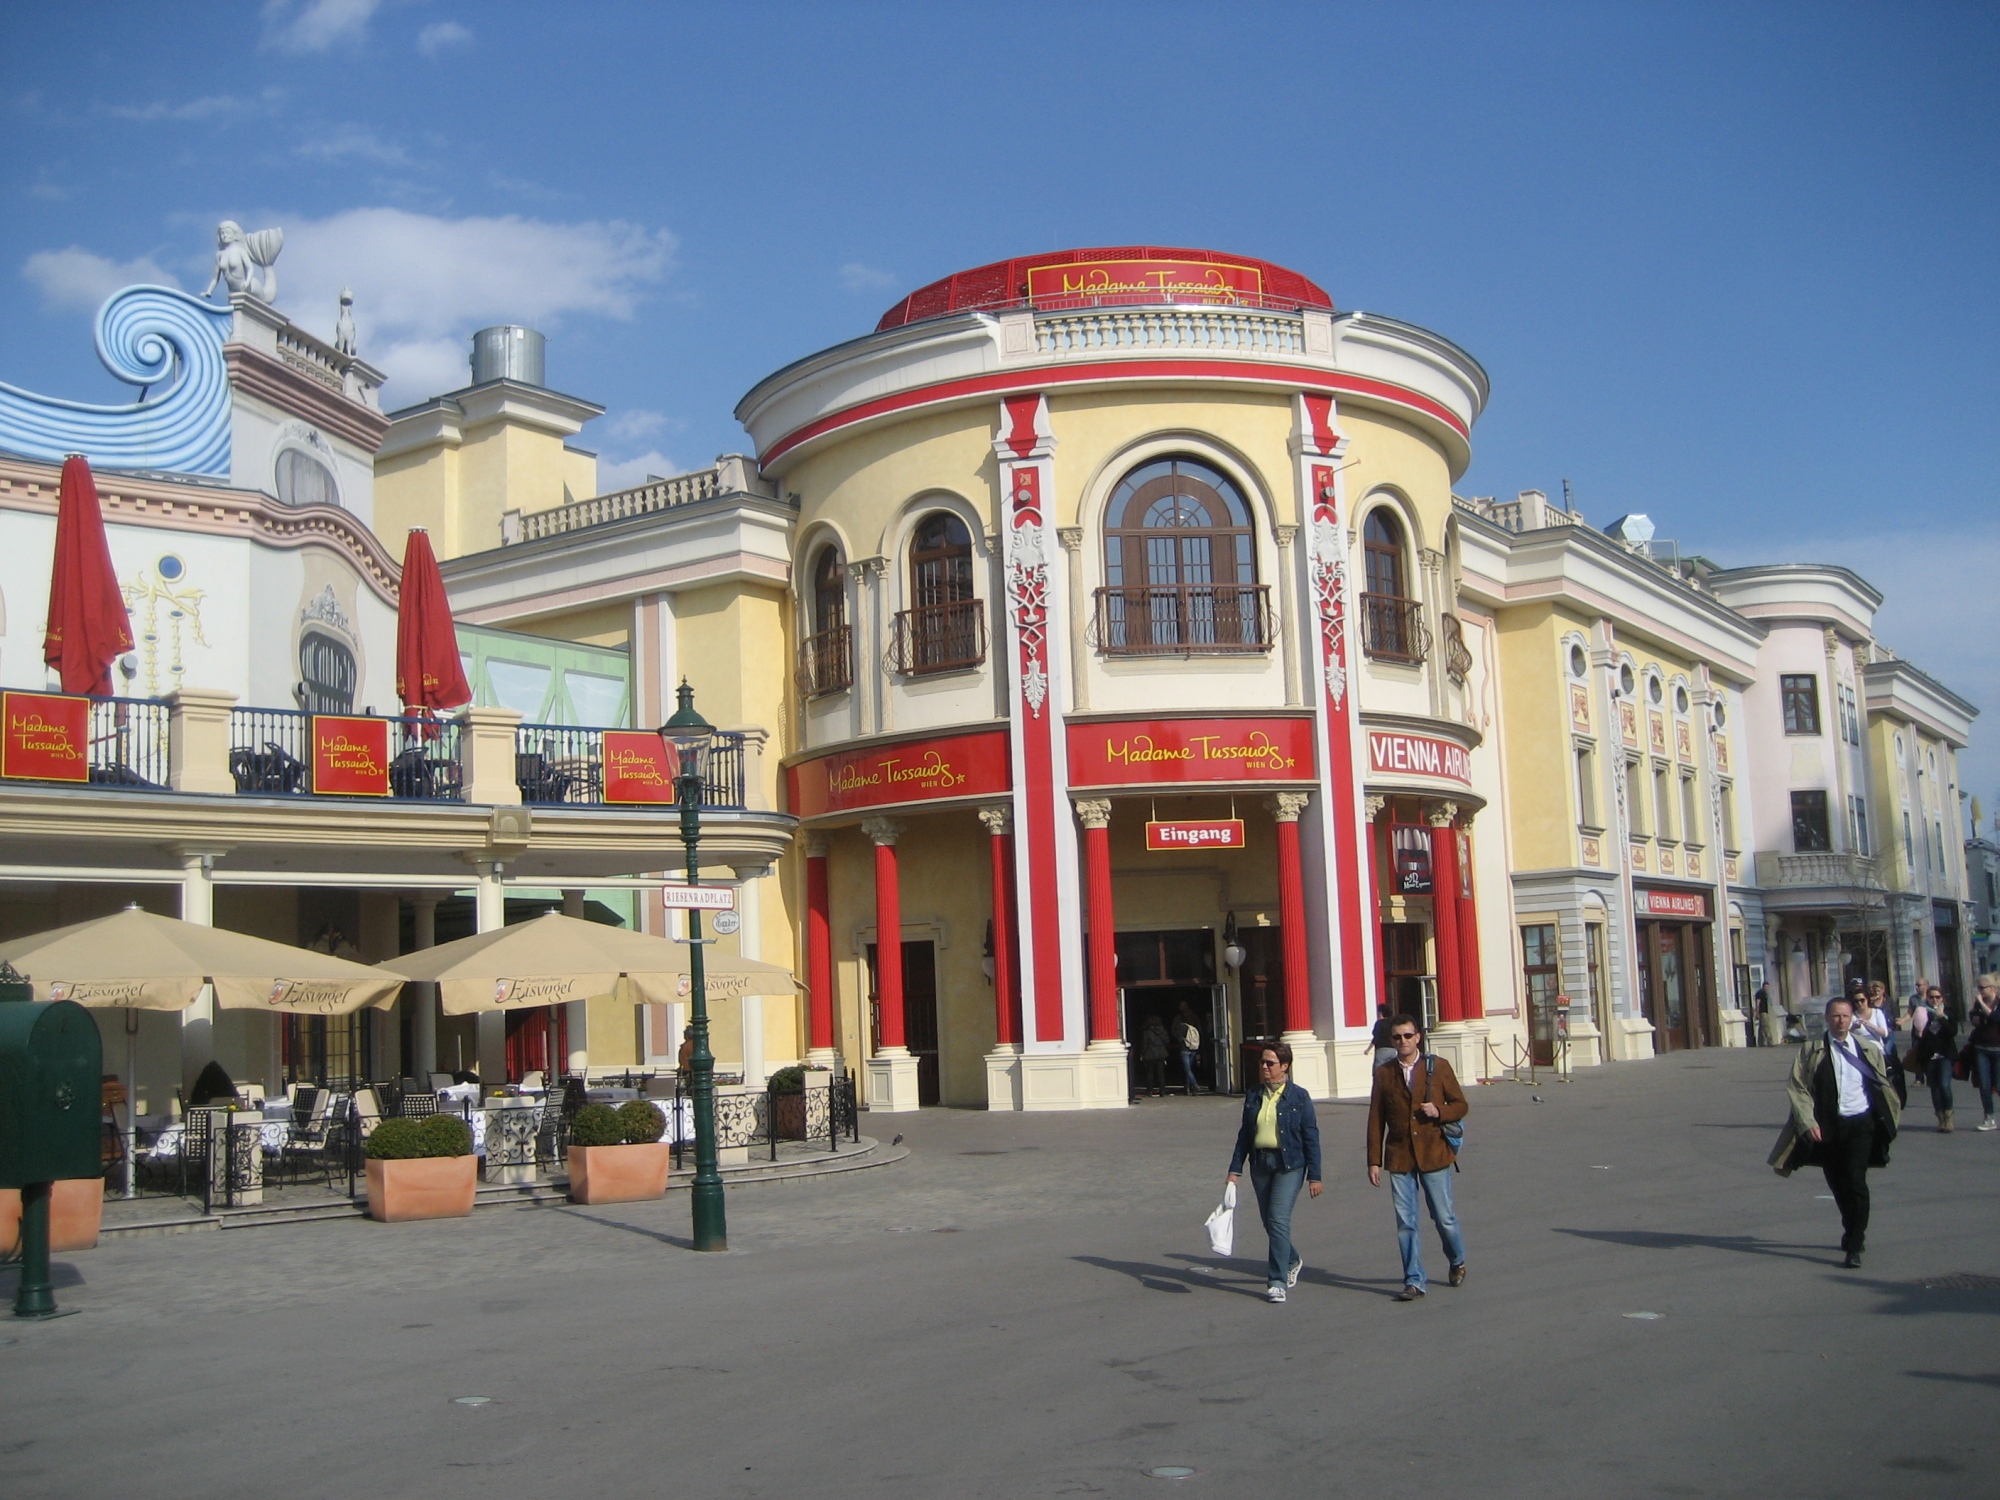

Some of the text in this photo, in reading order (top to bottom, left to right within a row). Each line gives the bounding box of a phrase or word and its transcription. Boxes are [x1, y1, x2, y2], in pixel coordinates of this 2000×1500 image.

[1063, 269, 1235, 304] Madame Tussauds
[12, 714, 69, 733] Madame
[14, 733, 76, 760] Tussauds
[321, 735, 371, 753] Madame
[1107, 731, 1284, 770] Madame Tussauds
[1370, 736, 1442, 774] VIENNA
[323, 752, 378, 776] Tussauds
[610, 748, 657, 766] Madame
[1246, 761, 1266, 769] WIEN
[612, 764, 663, 786] Tussauds
[829, 750, 955, 794] Madame Tussauds
[920, 780, 938, 788] WIEN
[1159, 827, 1232, 844] Eingang
[666, 891, 732, 904] RIESENRADPLATZ
[1649, 895, 1695, 911] VIENNA AIRLINES
[51, 981, 147, 1006] Eisvogel
[269, 978, 354, 1013] Eisvogel
[494, 977, 576, 1003] Eisvogel
